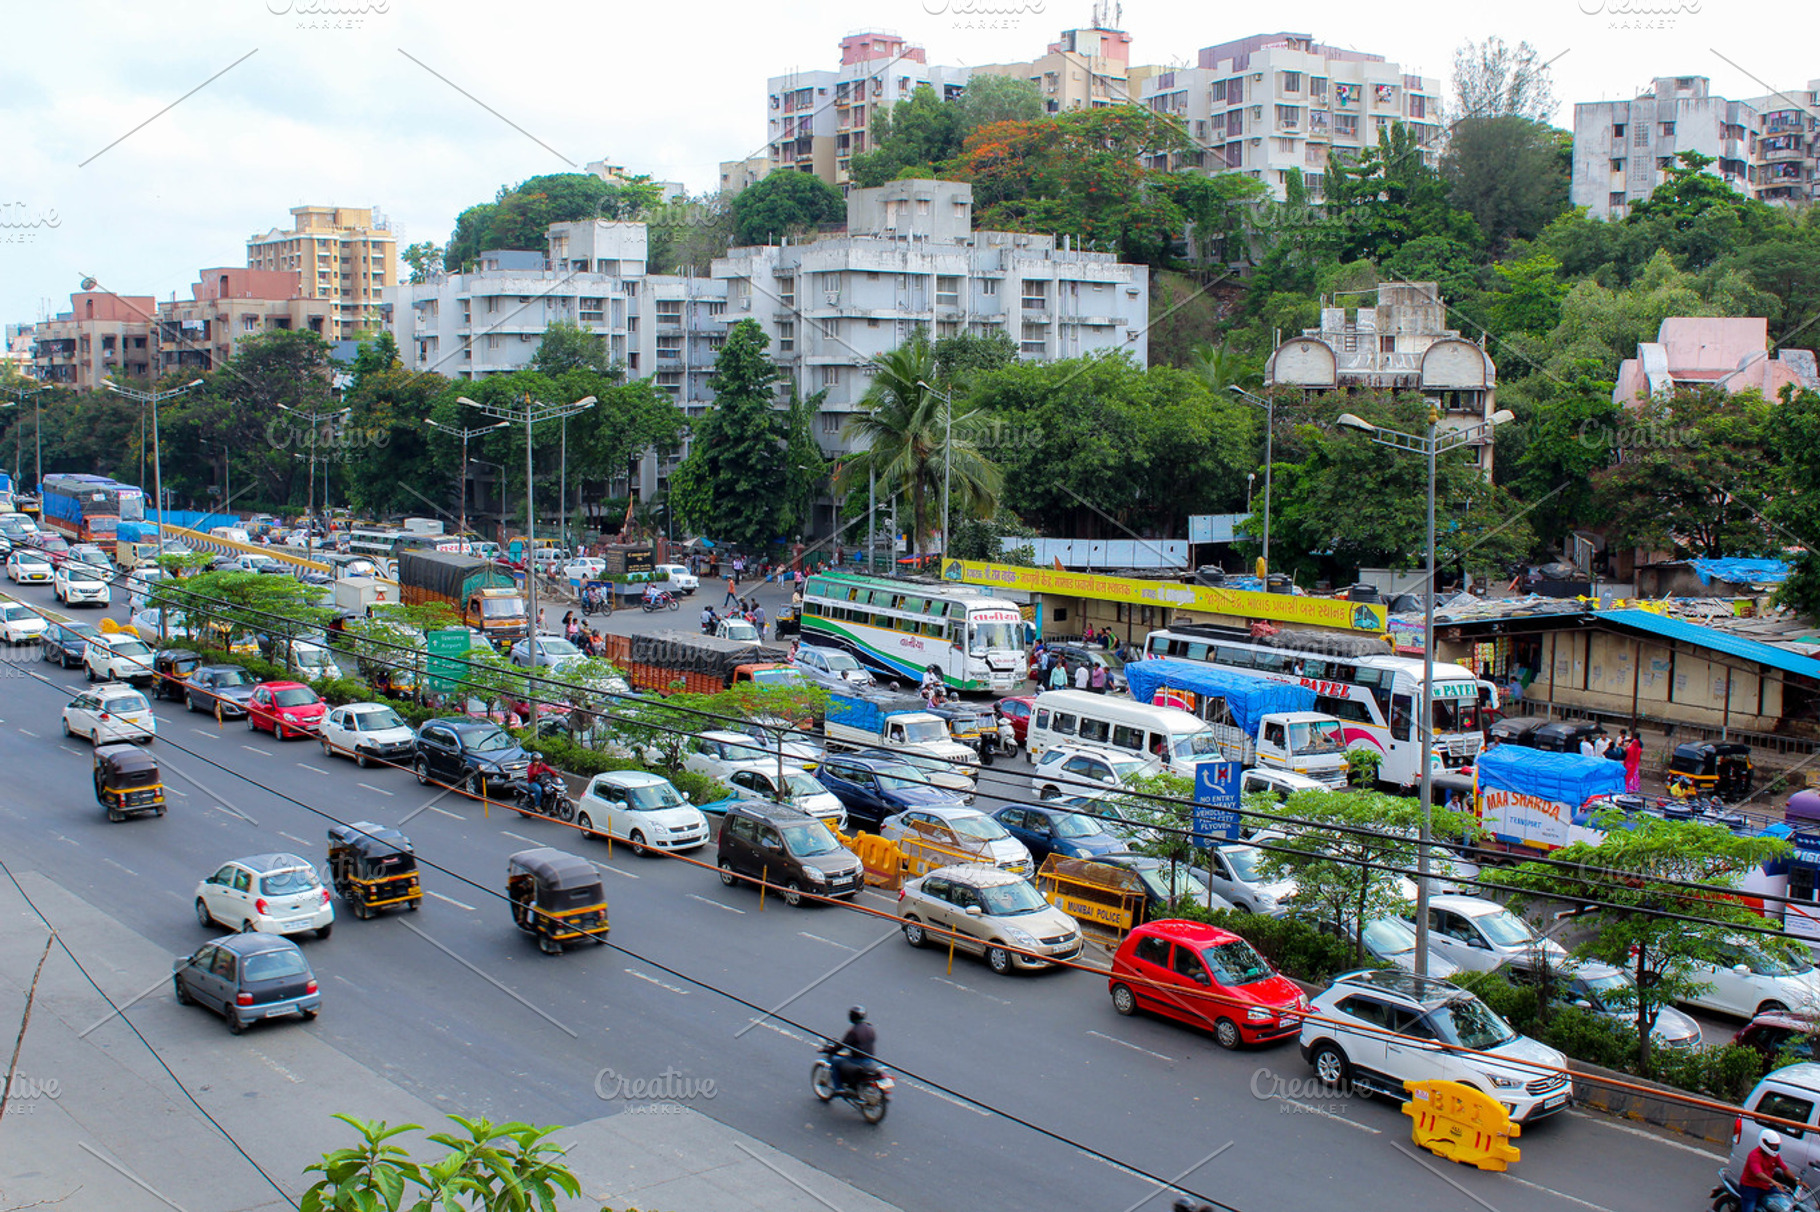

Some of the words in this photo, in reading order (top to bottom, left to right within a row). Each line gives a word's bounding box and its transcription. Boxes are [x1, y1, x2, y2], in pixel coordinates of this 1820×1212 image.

[1247, 598, 1270, 612] માલાડ
[1301, 603, 1315, 617] બસ
[1319, 604, 1345, 620] સ્થાનક
[1299, 677, 1351, 699] PATEL
[1212, 794, 1234, 803] ENTRY
[1486, 791, 1508, 811] MAA
[1511, 792, 1561, 822] SHARDA
[1200, 823, 1231, 831] FLYOVER
[1068, 901, 1094, 916] MUMBAI
[1096, 908, 1120, 923] POLICE
